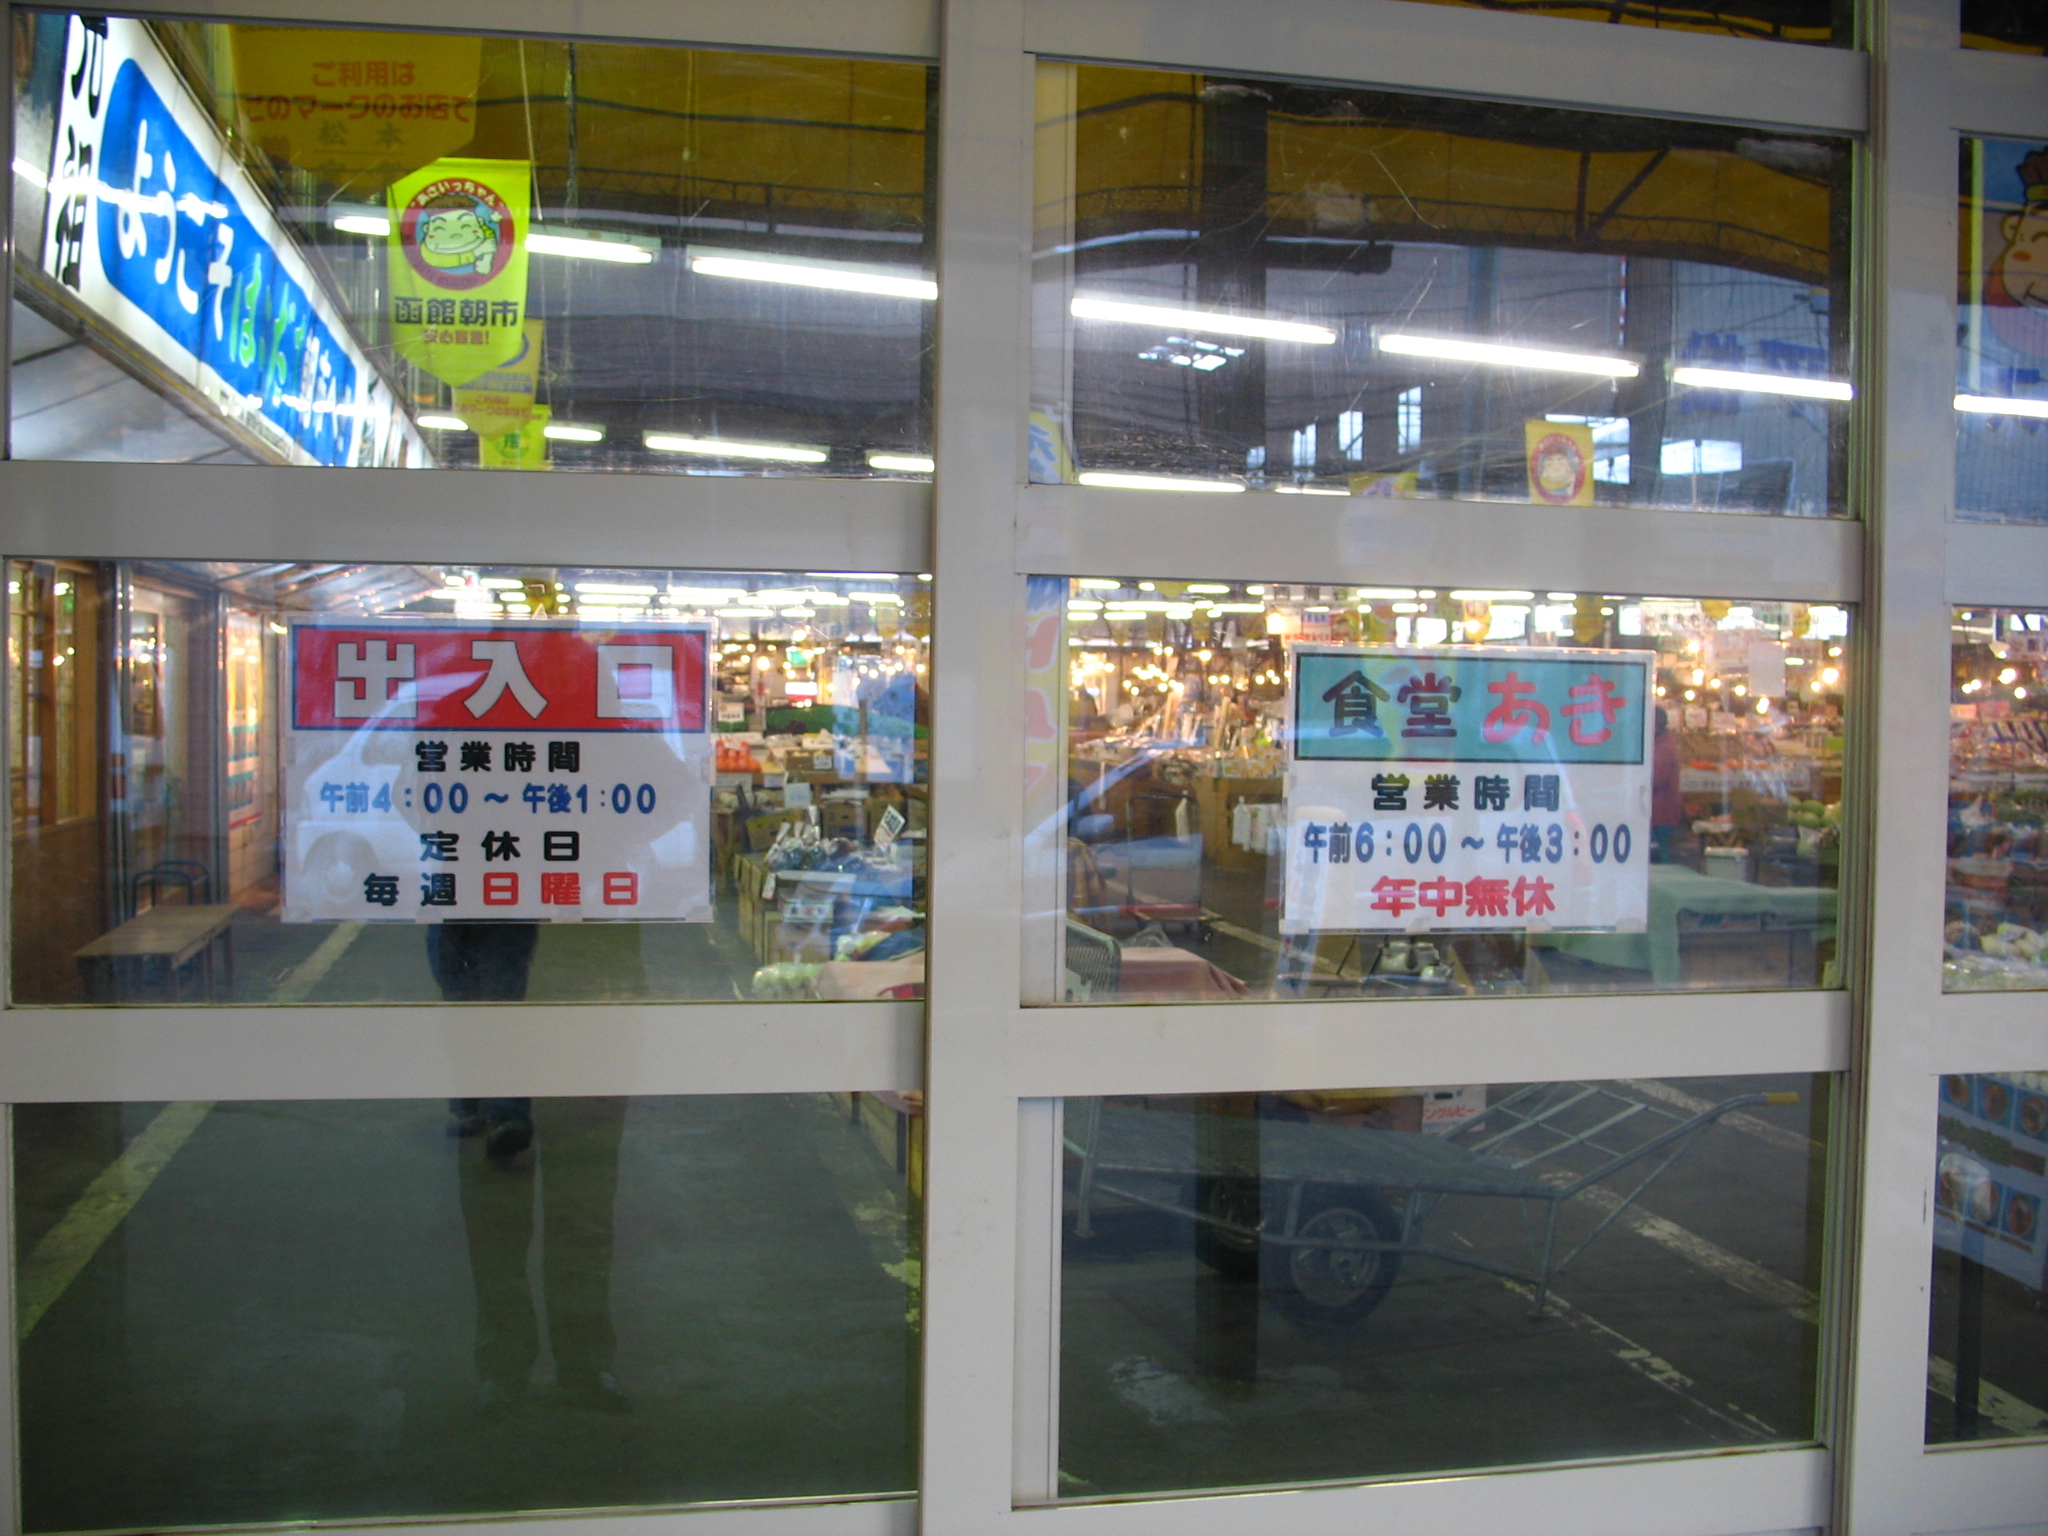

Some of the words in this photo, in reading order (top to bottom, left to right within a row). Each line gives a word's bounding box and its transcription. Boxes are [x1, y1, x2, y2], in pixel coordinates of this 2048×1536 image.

[313, 61, 415, 87] ご利用は
[395, 297, 519, 327] 函館朝市
[333, 639, 674, 719] 出入口
[1322, 669, 1627, 746] 食堂あき
[415, 741, 581, 773] 営業時間
[1371, 773, 1561, 812] 営業時間
[420, 830, 580, 862] 定休日
[363, 871, 639, 907] 毎週日曜日
[1370, 875, 1556, 918] 年中無休
